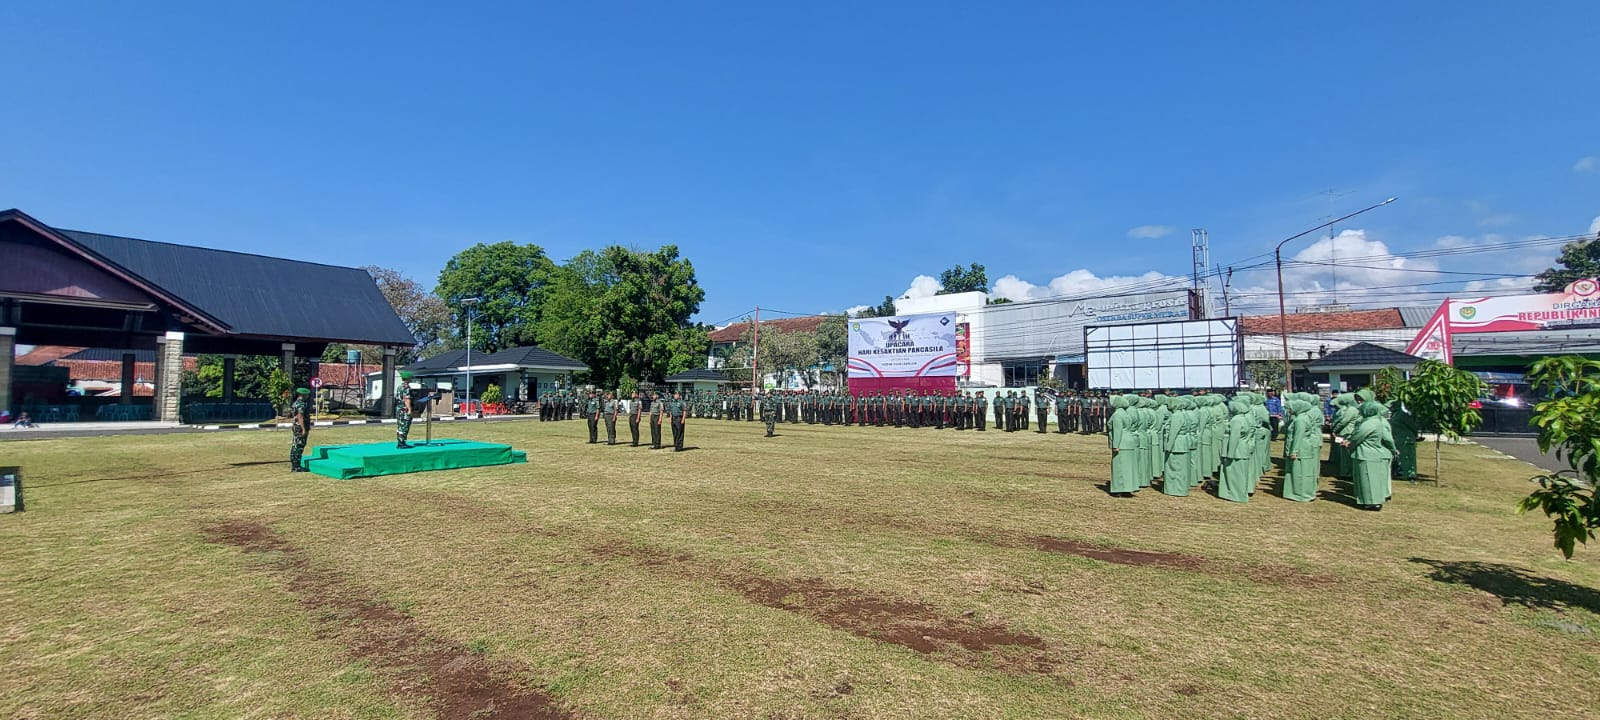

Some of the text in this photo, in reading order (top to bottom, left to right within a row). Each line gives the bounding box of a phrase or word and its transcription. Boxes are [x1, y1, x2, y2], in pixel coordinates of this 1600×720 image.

[1518, 309, 1600, 321] REPUBLIK IN
[907, 346, 944, 354] PANCASILA
